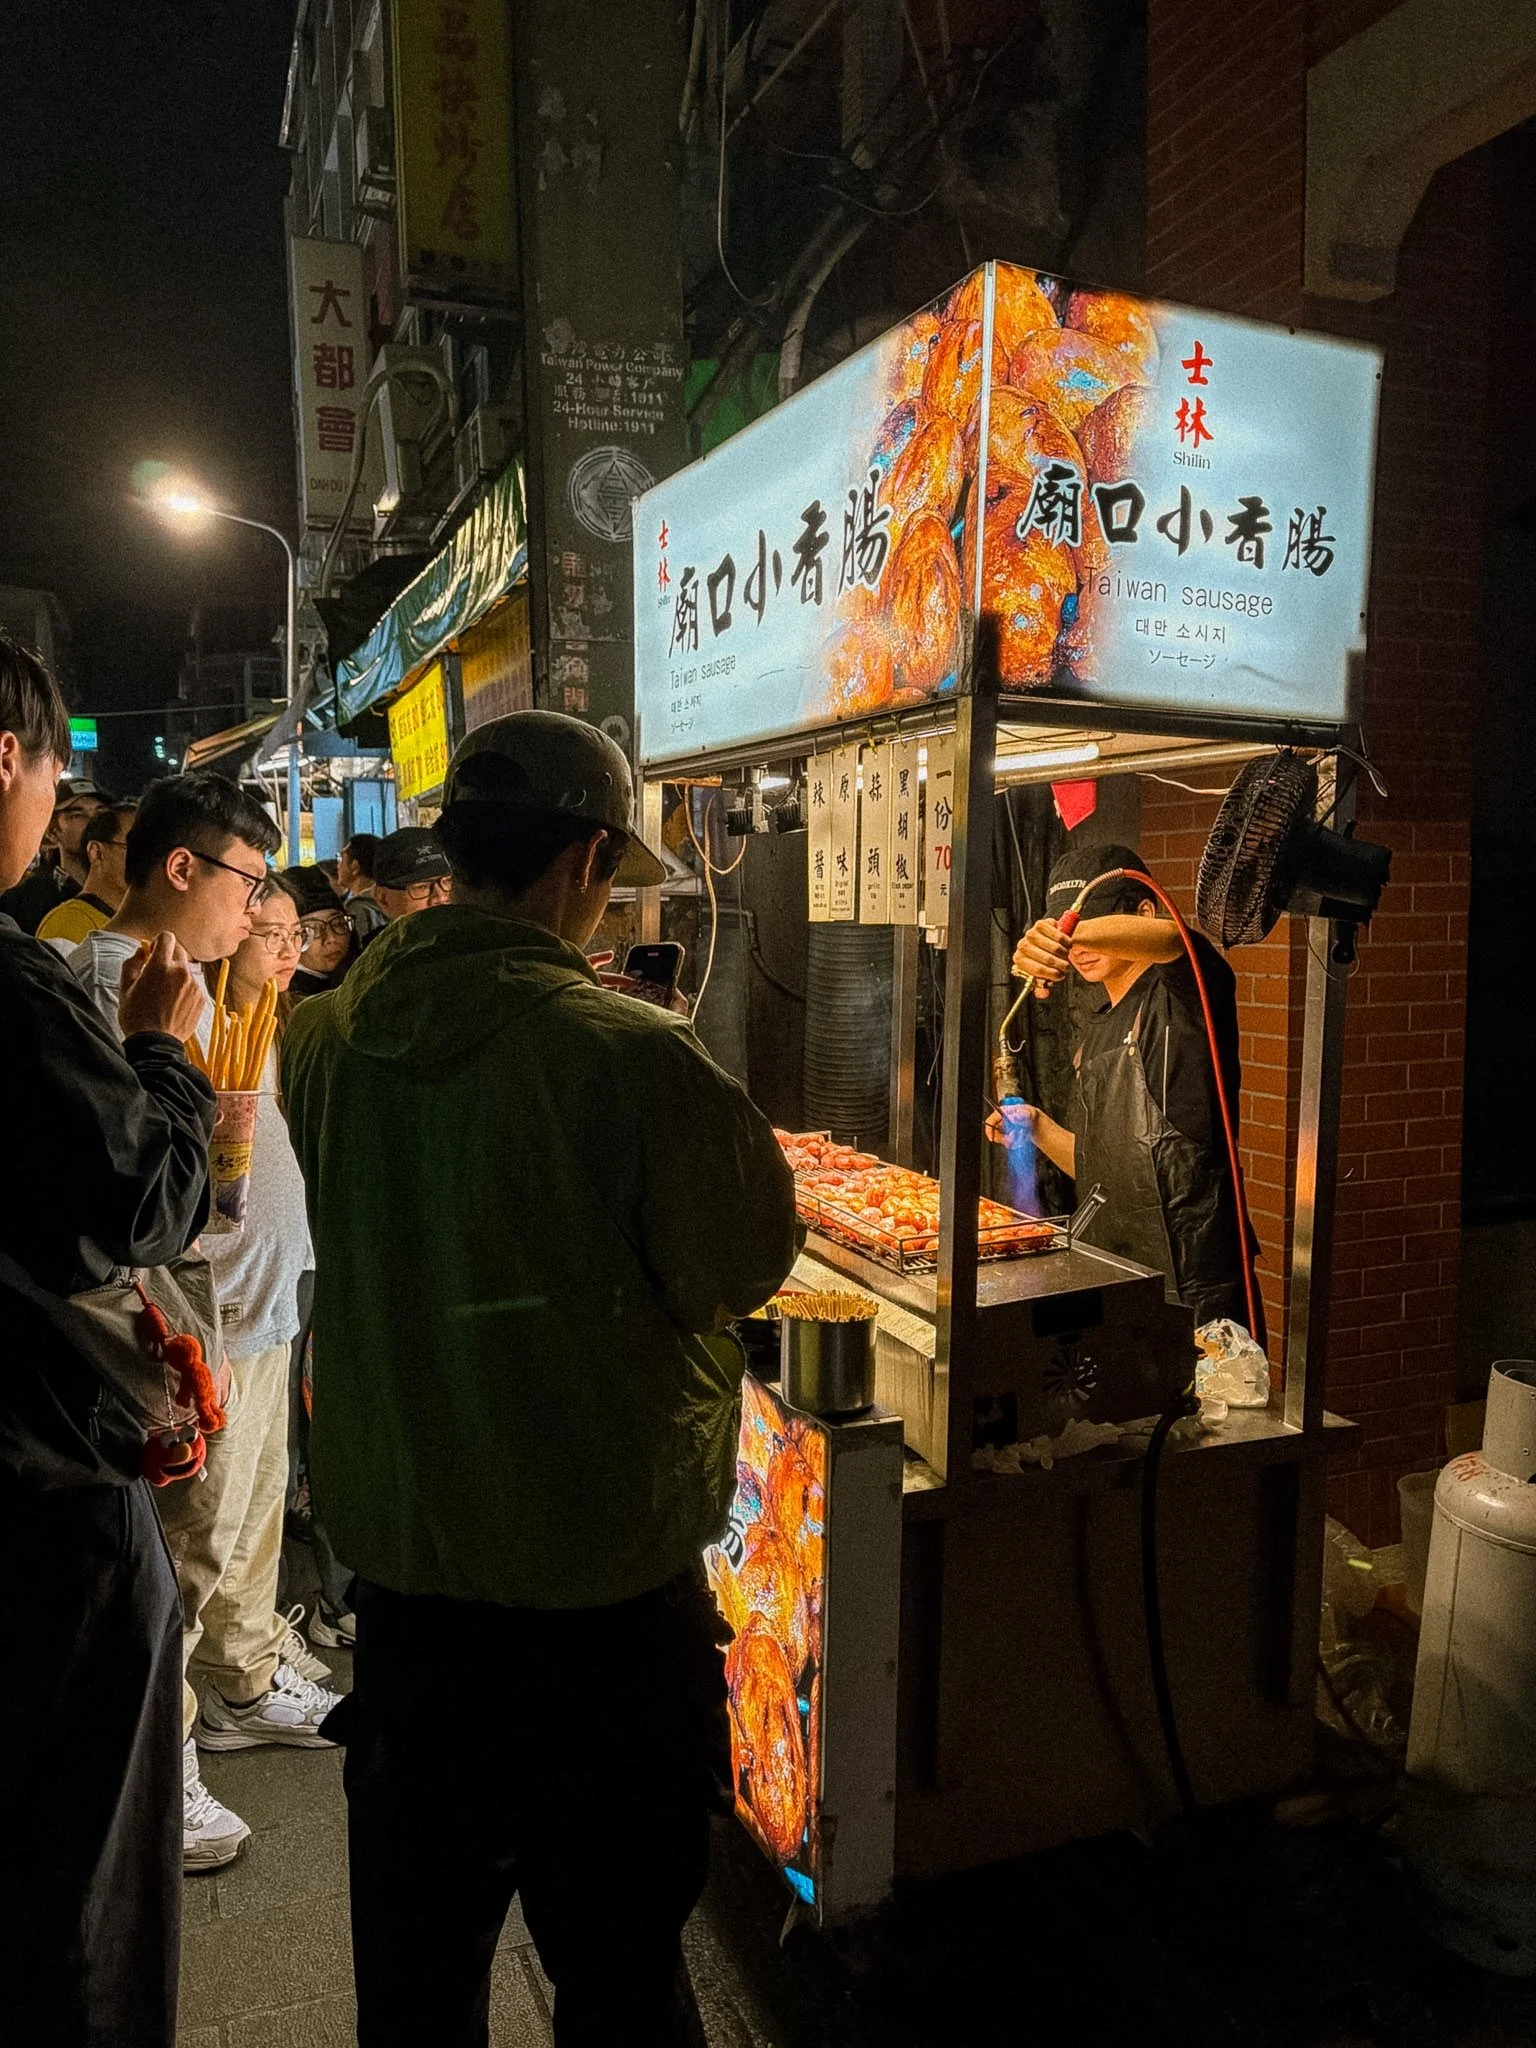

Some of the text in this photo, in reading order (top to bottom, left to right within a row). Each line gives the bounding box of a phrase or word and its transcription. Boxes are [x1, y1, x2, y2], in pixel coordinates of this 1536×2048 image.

[308, 279, 356, 454] 大都會
[540, 352, 583, 369] Taiwan
[1173, 340, 1215, 449] 士林
[1172, 451, 1212, 471] Shilin
[657, 520, 672, 593] 士林
[1018, 463, 1337, 577] 廟口小香腸
[668, 468, 893, 659] 廟口小香腸
[1085, 566, 1273, 616] Taiwan sausage
[1135, 618, 1226, 644] 대만 소시지
[1149, 650, 1217, 669] ソーセージ
[670, 655, 736, 690] Taiwan sausage
[836, 772, 850, 877] 原味
[895, 768, 910, 881] 黑胡椒
